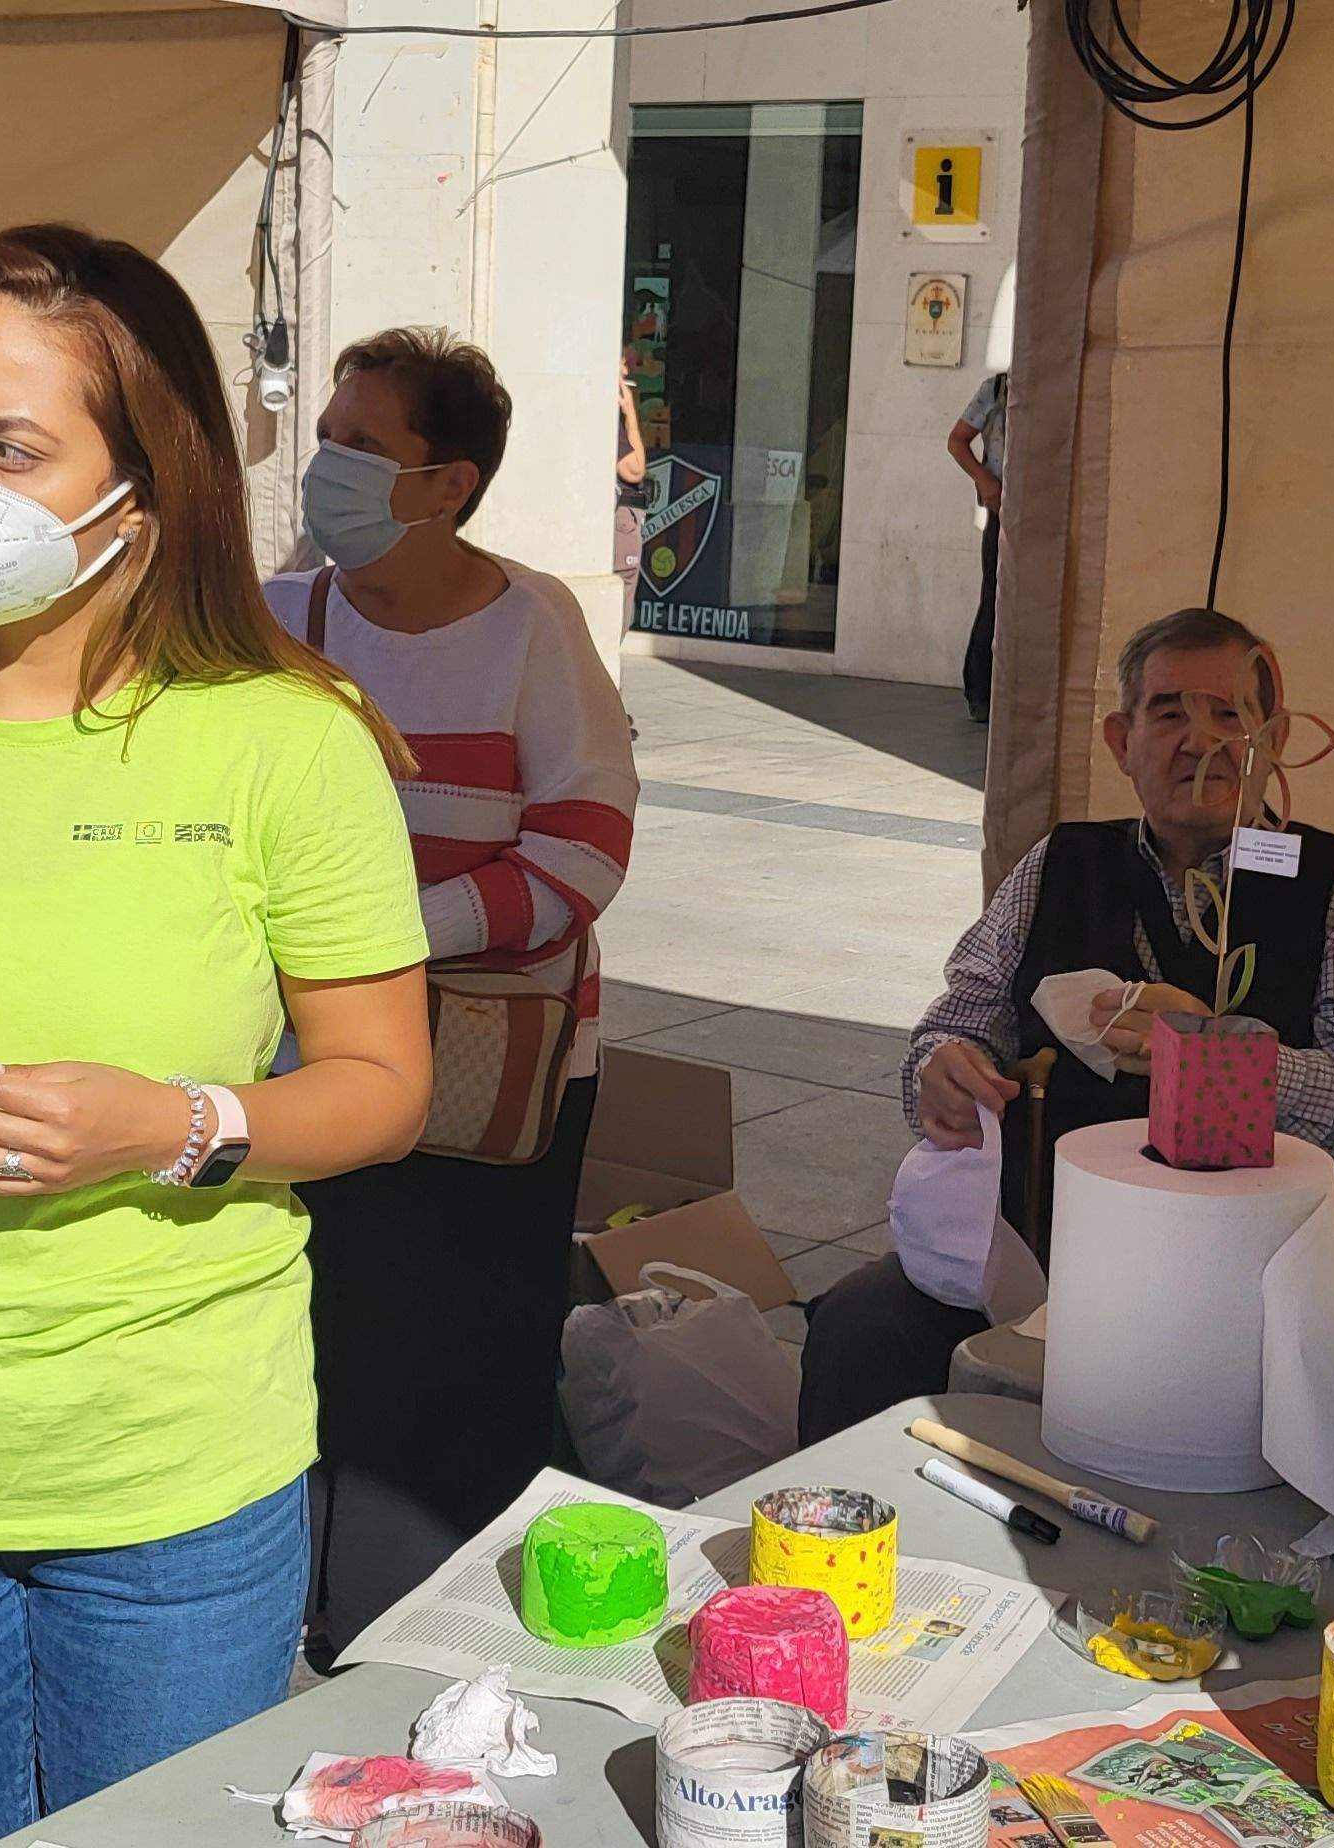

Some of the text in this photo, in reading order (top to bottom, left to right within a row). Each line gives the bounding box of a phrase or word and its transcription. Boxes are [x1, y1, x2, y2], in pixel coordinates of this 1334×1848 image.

[659, 485, 712, 527] HUESCA
[640, 600, 751, 641] DE LEYENDA
[193, 833, 206, 842] DE
